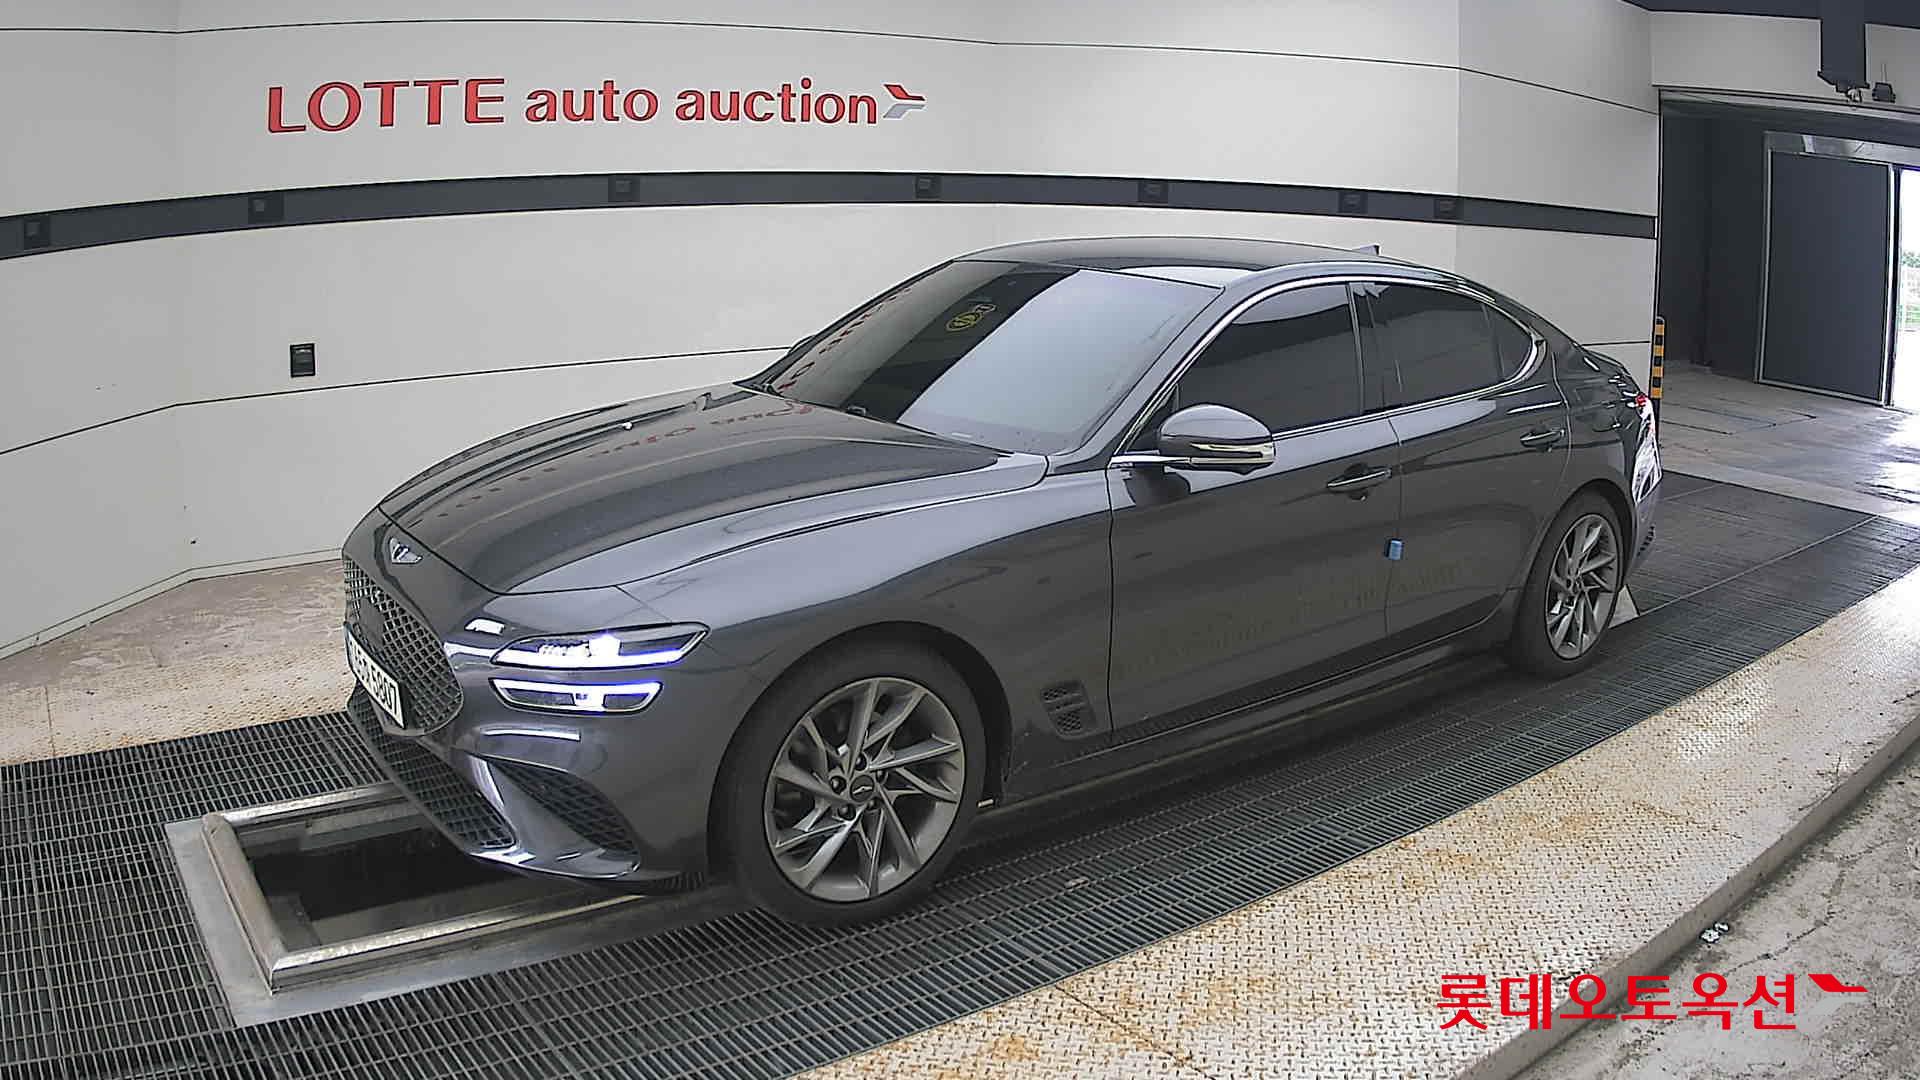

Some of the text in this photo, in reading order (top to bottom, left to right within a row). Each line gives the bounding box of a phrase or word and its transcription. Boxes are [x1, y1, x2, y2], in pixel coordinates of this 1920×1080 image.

[267, 78, 878, 134] LOTTE auto auction
